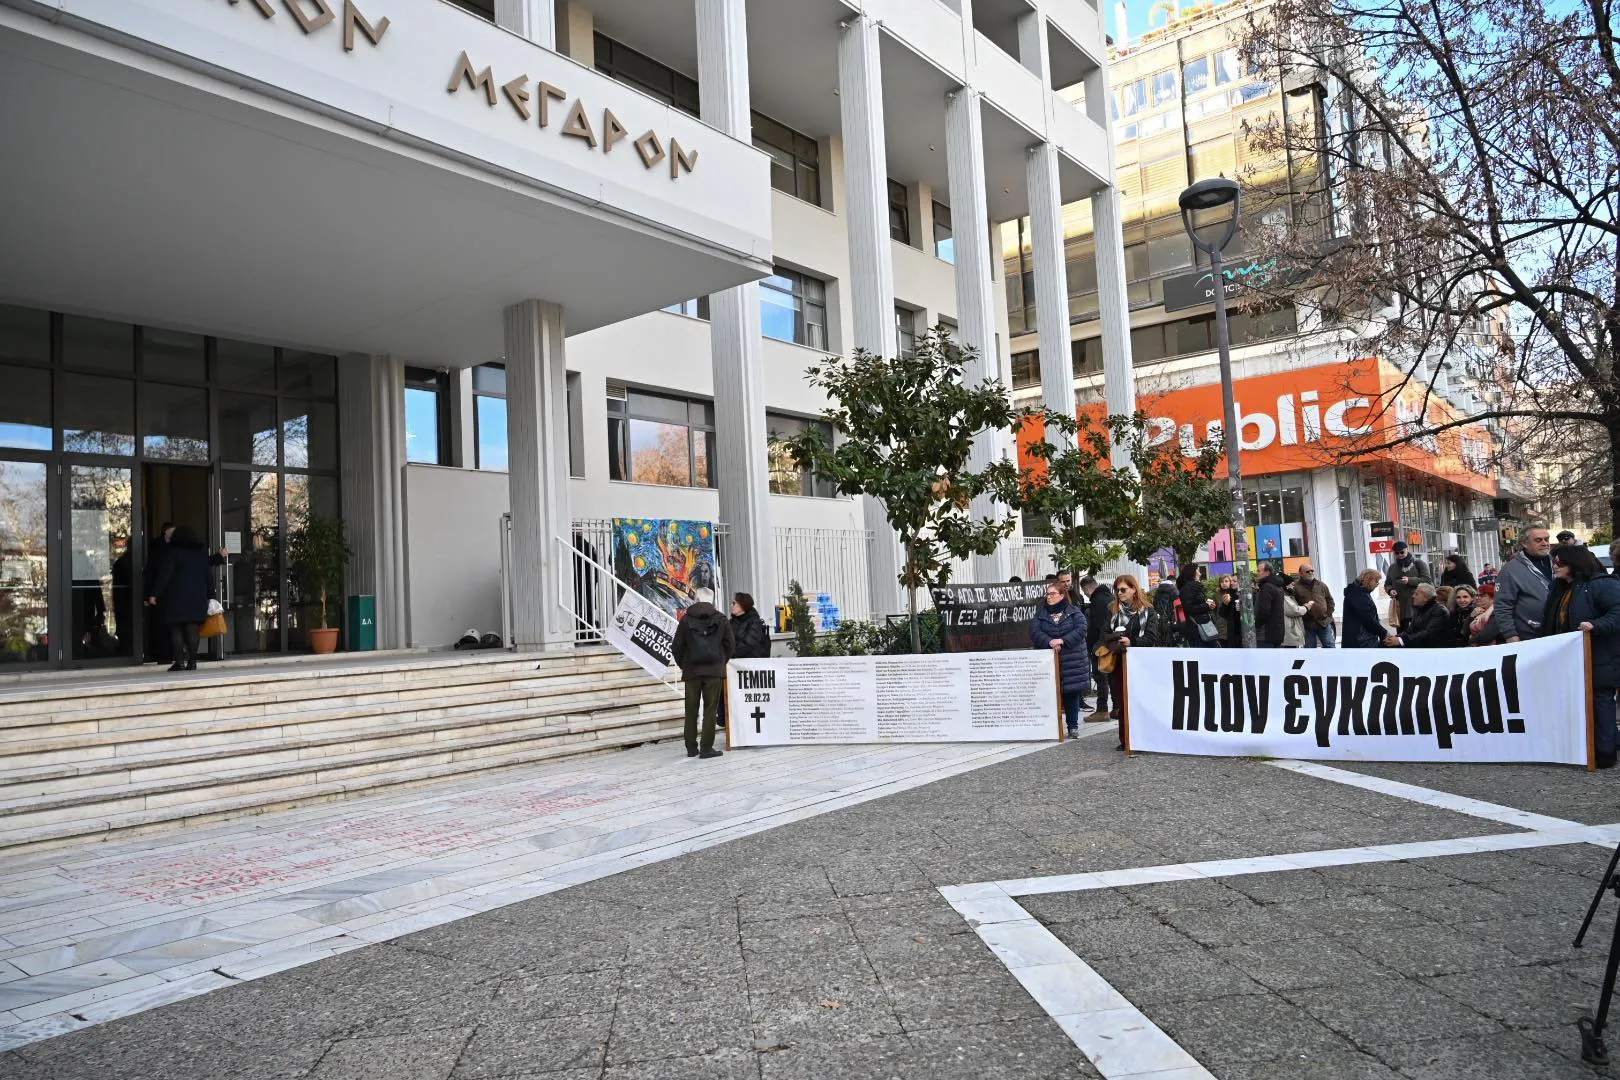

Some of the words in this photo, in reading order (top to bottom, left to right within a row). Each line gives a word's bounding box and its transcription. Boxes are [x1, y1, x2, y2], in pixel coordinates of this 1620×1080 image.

[448, 50, 698, 180] ΜΕΓΑΡΟΝ
[1142, 390, 1373, 459] Public
[639, 623, 658, 640] ΔΕΝ
[736, 669, 776, 690] ΤΕΜΠΗ
[744, 692, 771, 703] 28.02.23
[1171, 660, 1271, 735] Ηταν
[1283, 653, 1526, 749] έγκλημα!
